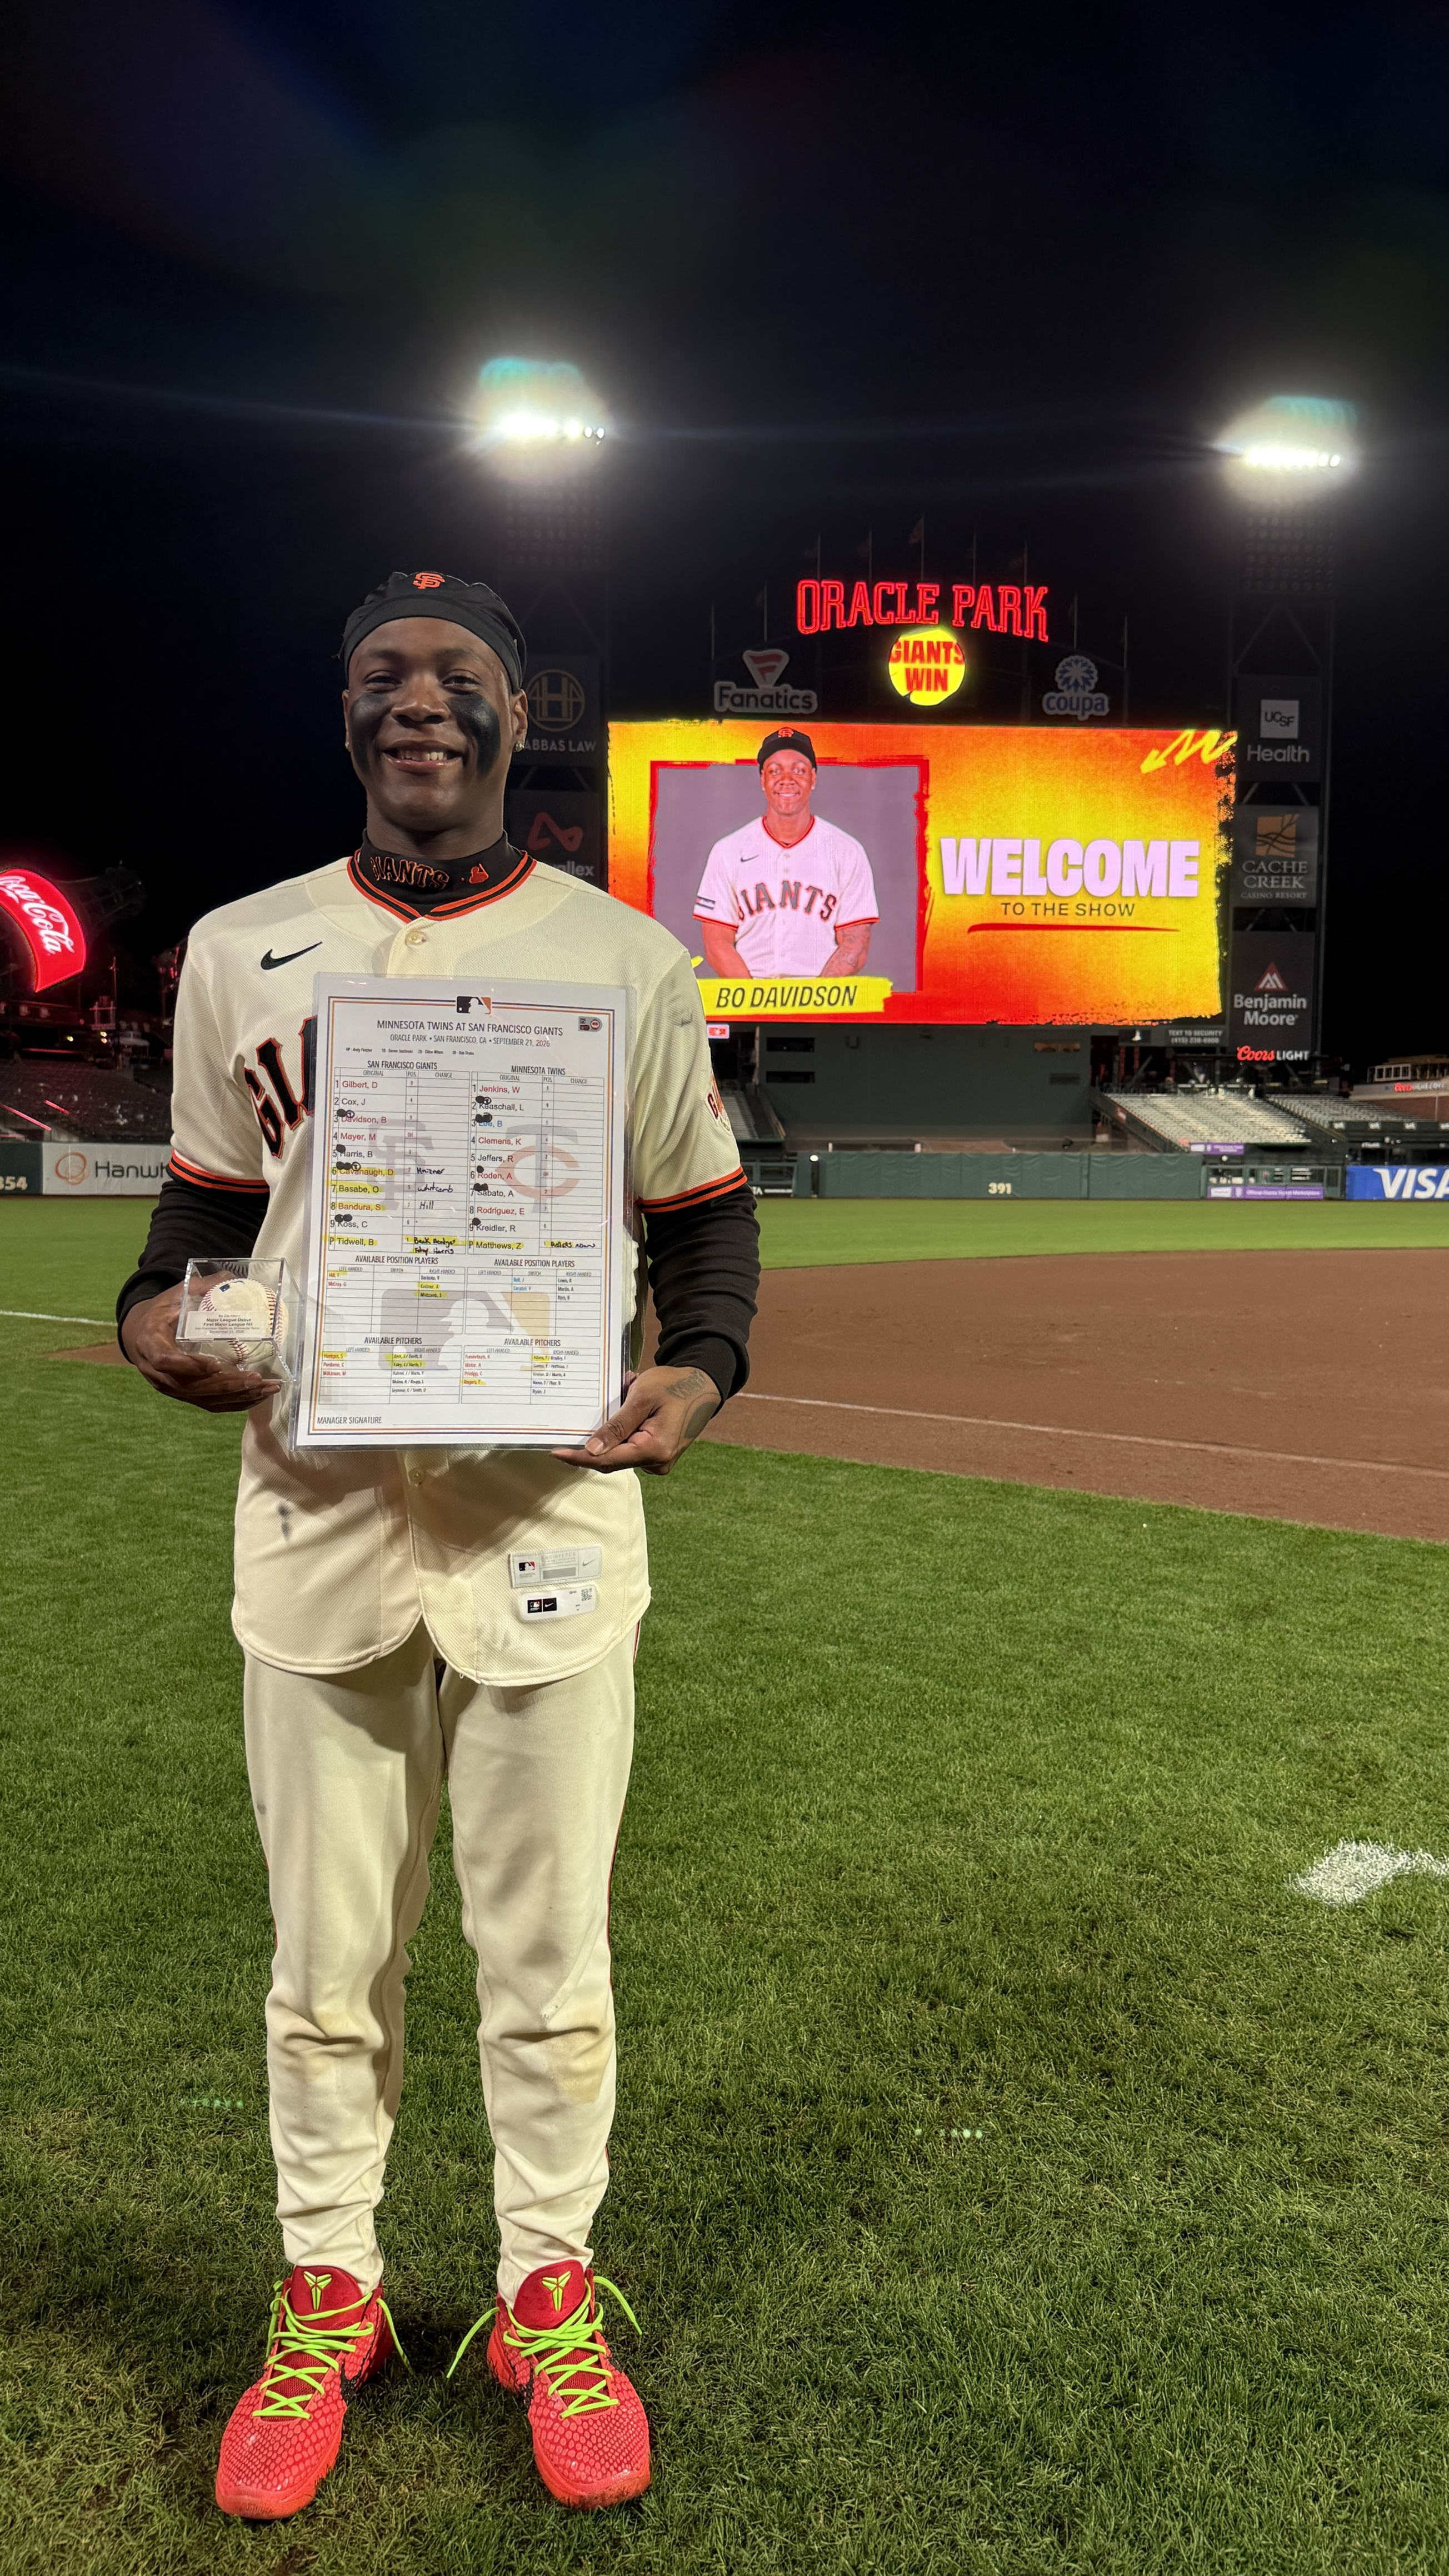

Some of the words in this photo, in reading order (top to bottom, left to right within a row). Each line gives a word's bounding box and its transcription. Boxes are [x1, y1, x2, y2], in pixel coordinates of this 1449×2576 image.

[797, 579, 940, 635] ORACLE
[952, 584, 1048, 643] PARK
[890, 640, 965, 665] GIANTS
[905, 667, 948, 692] WIN
[722, 685, 813, 711] Fanatics
[1046, 692, 1106, 717] coupa
[524, 739, 565, 752] ABBAS
[569, 740, 596, 753] LAW
[1247, 745, 1310, 763] Health
[940, 837, 1200, 898] WELCOME
[1242, 860, 1308, 874] CACHE
[1243, 875, 1305, 889] CREEK
[1001, 902, 1024, 916] TO
[1031, 903, 1068, 916] THE
[1075, 903, 1135, 917] SHOW
[716, 987, 745, 1009] BO
[750, 985, 857, 1007] DAVIDSON
[1233, 994, 1307, 1012] Benjamin
[1243, 1011, 1296, 1026] Moore
[377, 1020, 425, 1030] MINNESOTA
[427, 1021, 454, 1031] TWINS
[455, 1022, 467, 1031] AT
[468, 1022, 485, 1032] SAN
[487, 1024, 532, 1034] FRANCISCO
[534, 1026, 563, 1036] GIANTS
[446, 1035, 478, 1044] FRANCISCO,
[493, 1037, 524, 1046] SEPTEMBER
[526, 1039, 534, 1047] 21,
[1236, 1045, 1275, 1061] Coors
[1276, 1050, 1310, 1061] LIGHT
[381, 1060, 414, 1069] FRANCISCO
[416, 1061, 437, 1070] GIANTS
[511, 1065, 546, 1075] MINNESOTA
[547, 1067, 566, 1075] TWINS
[342, 1081, 369, 1089] Gilbert,
[472, 1084, 476, 1092] 1
[334, 1097, 339, 1106] 2
[472, 1101, 477, 1110] 2
[334, 1114, 338, 1122] 3
[340, 1133, 366, 1141] Mayer,
[478, 1137, 513, 1146] Clemens,
[477, 1154, 504, 1163] Jeffers,
[95, 1161, 168, 1179] Hanwh
[332, 1167, 337, 1175] 6
[470, 1171, 475, 1179] 6
[477, 1172, 504, 1180] Roden,
[331, 1184, 336, 1192] 7
[338, 1185, 370, 1194] Basabe,
[987, 1182, 1012, 1195] 391
[331, 1202, 336, 1210] 8
[338, 1202, 373, 1211] Bandura,
[419, 1200, 434, 1210] Hill
[469, 1206, 474, 1214] 8
[477, 1206, 517, 1216] Rodriguez,
[330, 1219, 335, 1228] 9
[469, 1223, 473, 1231] 9
[476, 1224, 507, 1232] Kreidler,
[329, 1237, 334, 1245] P
[337, 1237, 366, 1246] Tidwell,
[469, 1240, 473, 1249] P
[476, 1241, 514, 1250] Matthews,
[355, 1255, 386, 1264] AVAILABLE
[387, 1256, 413, 1264] POSITION
[494, 1259, 523, 1267] AVAILABLE
[524, 1259, 550, 1267] POSITION
